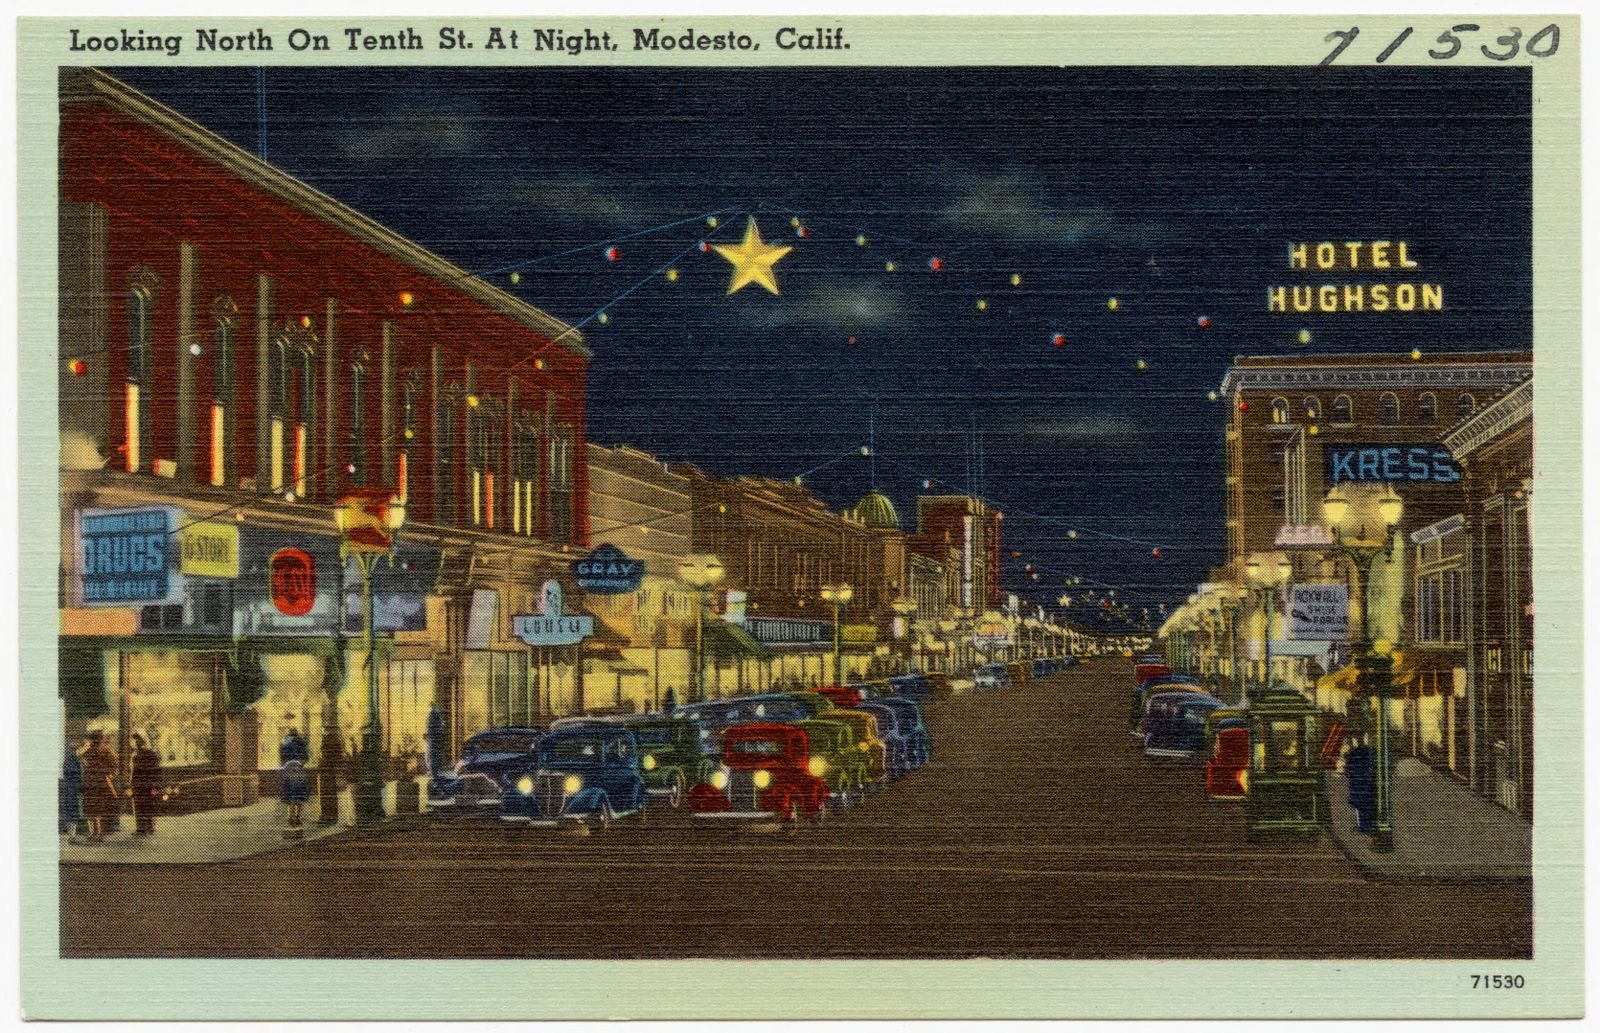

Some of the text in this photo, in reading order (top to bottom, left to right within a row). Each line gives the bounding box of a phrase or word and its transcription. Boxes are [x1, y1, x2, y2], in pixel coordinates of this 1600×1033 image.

[1288, 241, 1418, 269] HOTEL
[1267, 284, 1442, 312] HUGHSON
[1333, 447, 1462, 482] KRESS
[83, 533, 164, 574] DRUGS
[577, 562, 634, 576] GRAY
